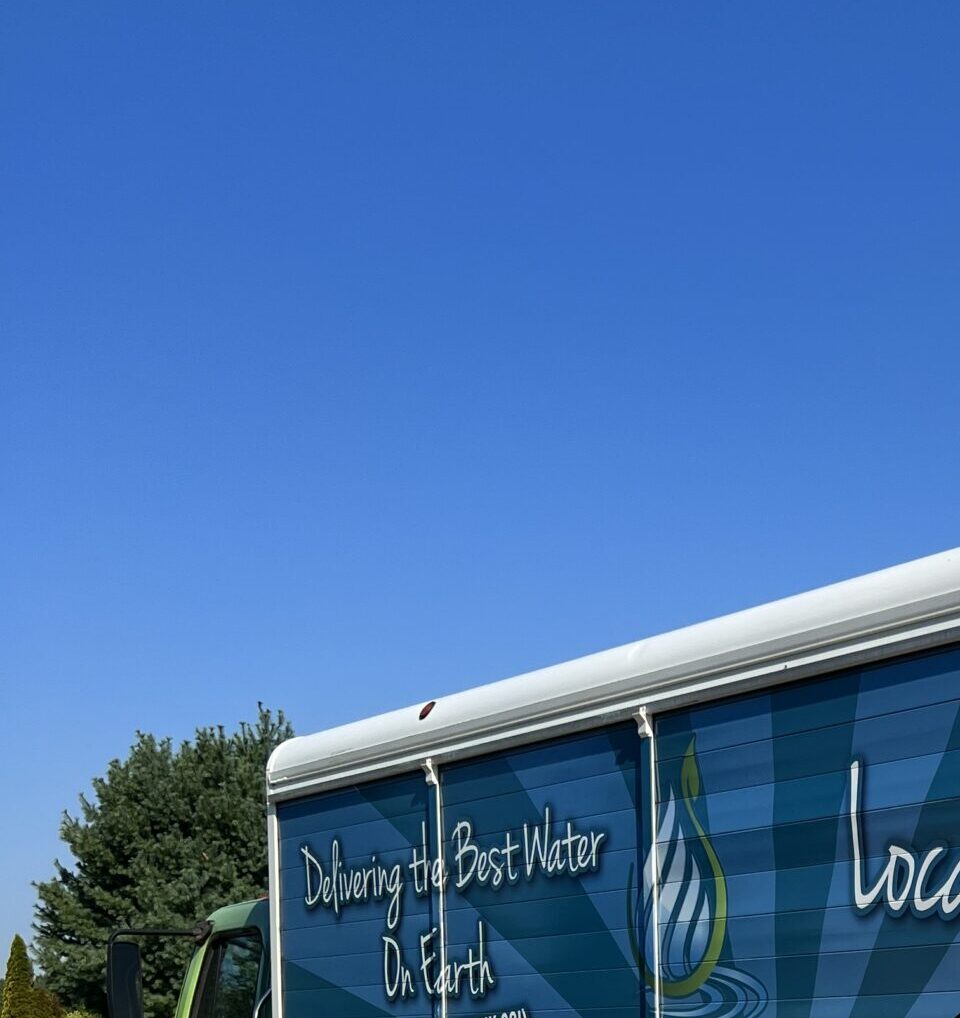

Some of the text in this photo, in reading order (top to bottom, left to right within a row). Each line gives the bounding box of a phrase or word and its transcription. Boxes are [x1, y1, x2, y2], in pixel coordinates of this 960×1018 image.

[301, 806, 605, 929] Delivering the Best Water
[382, 920, 495, 997] On Earth
